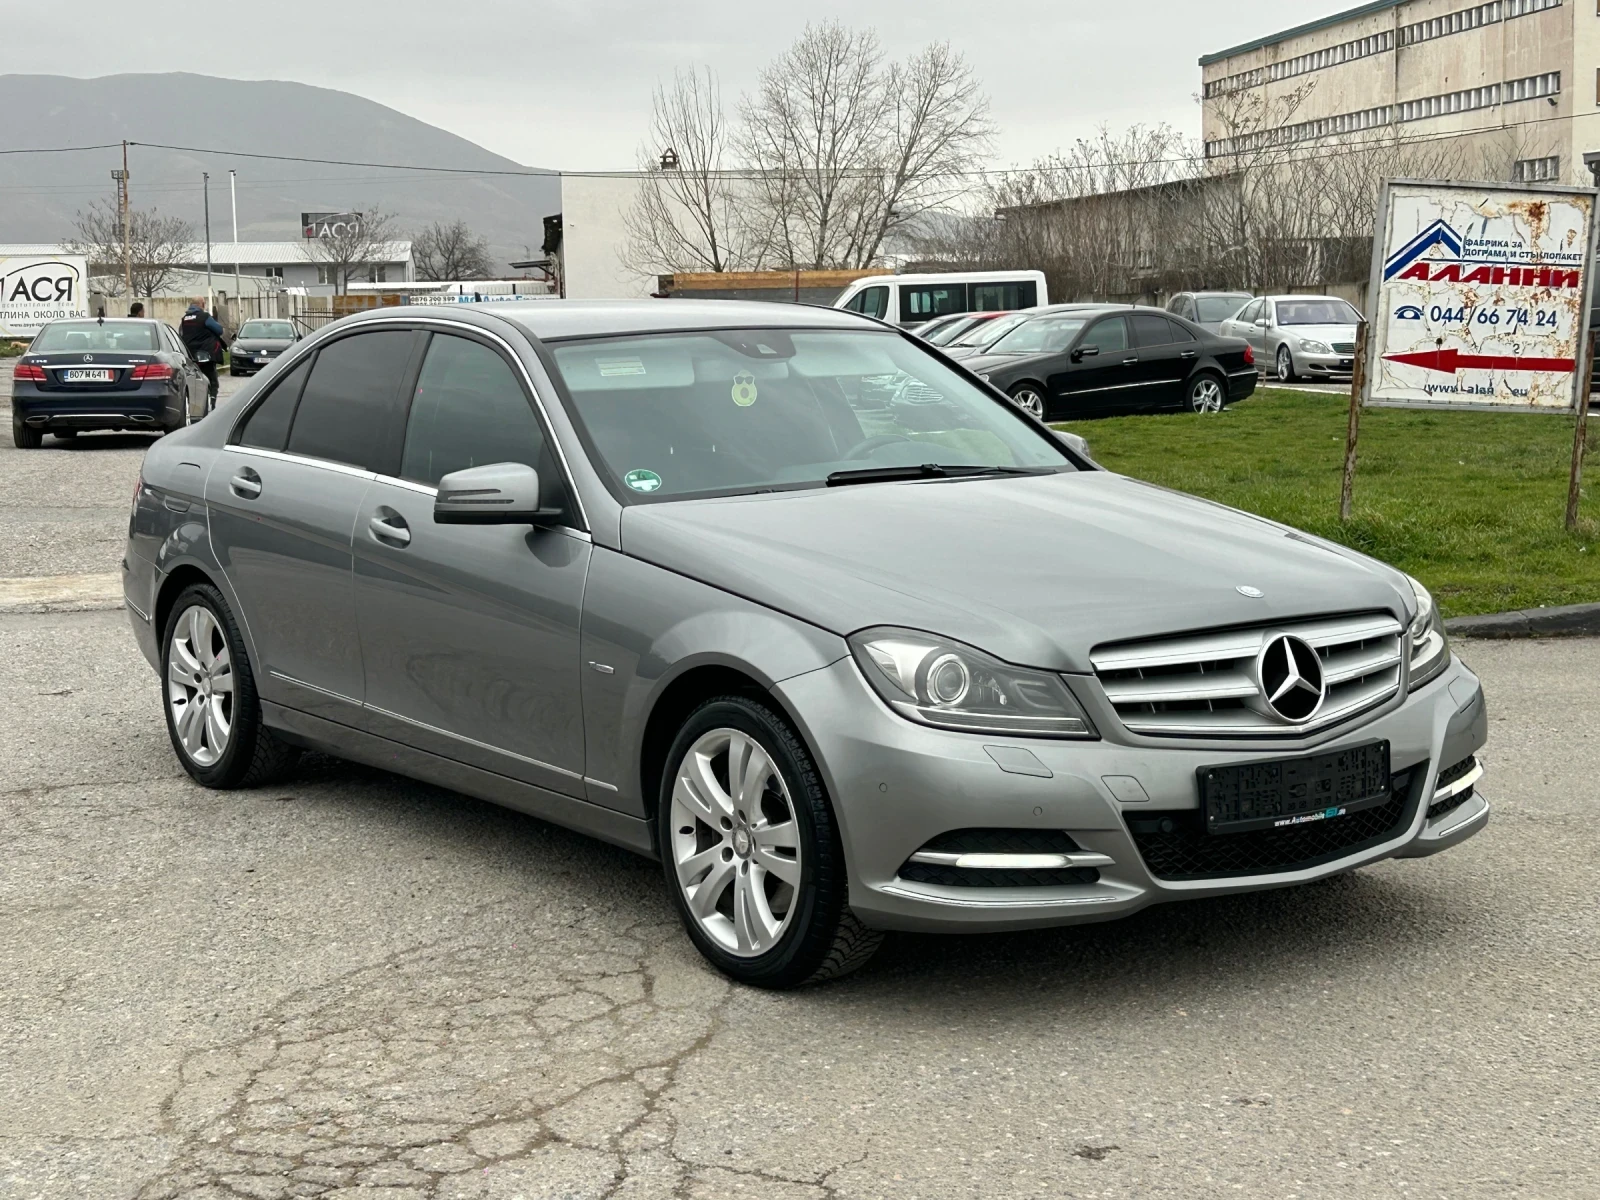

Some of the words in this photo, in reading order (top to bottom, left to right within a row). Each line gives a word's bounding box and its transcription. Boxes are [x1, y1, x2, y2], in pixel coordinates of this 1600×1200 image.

[1466, 239, 1509, 248] ФАБРИКА
[1511, 241, 1523, 249] ЗА
[1464, 249, 1507, 258] ДОГРАМА
[1398, 263, 1579, 287] АЛАННИ
[9, 275, 73, 302] АСЯ
[33, 310, 66, 319] ОКОЛО
[69, 310, 87, 318] ВАС
[1506, 309, 1529, 326] 74
[1535, 309, 1557, 327] 24
